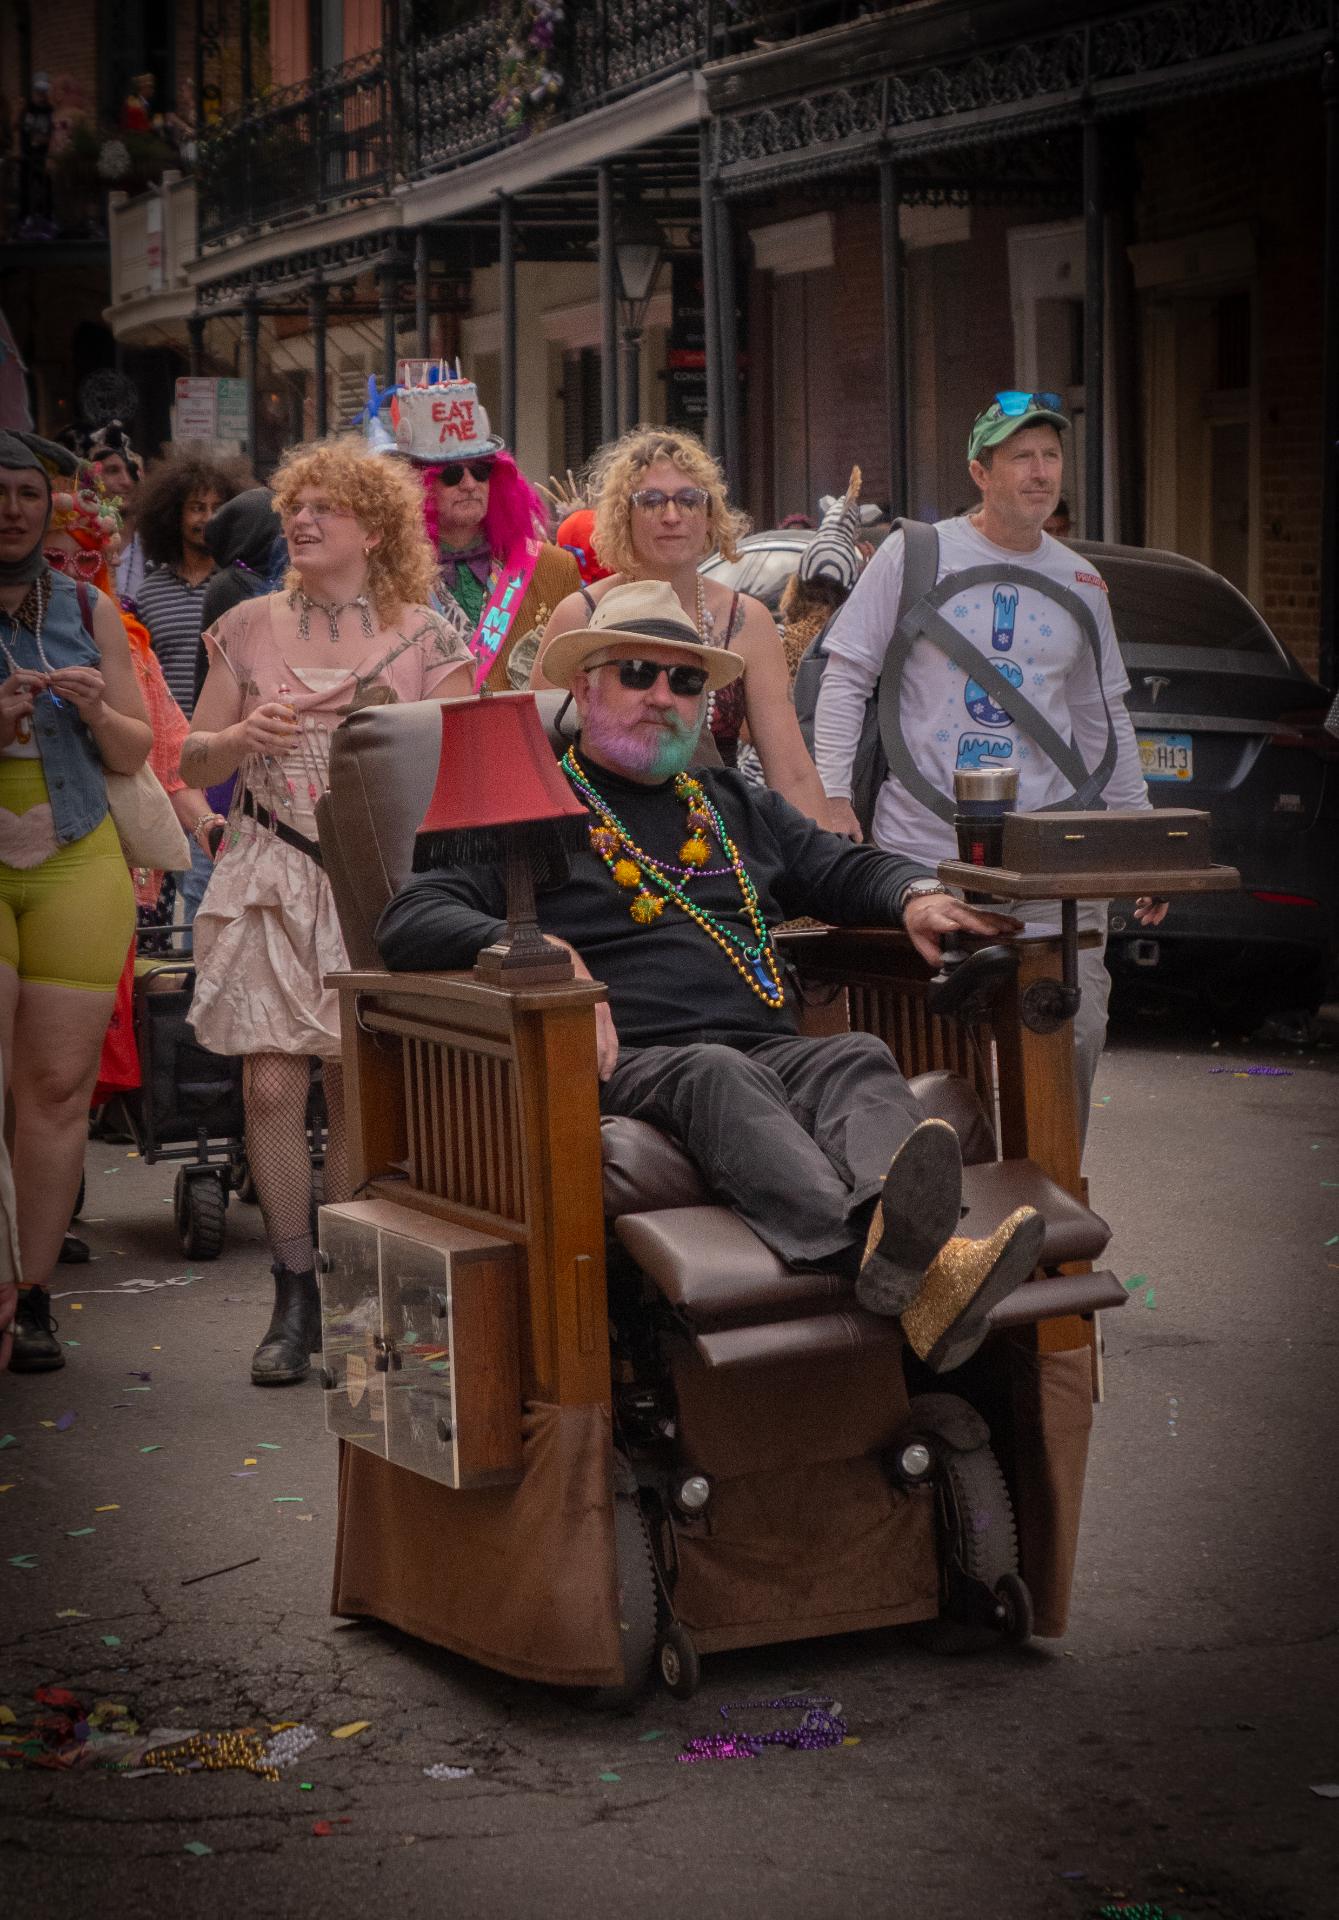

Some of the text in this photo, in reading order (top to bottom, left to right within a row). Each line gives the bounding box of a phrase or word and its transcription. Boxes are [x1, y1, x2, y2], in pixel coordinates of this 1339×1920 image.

[432, 400, 474, 422] EAT
[439, 419, 477, 443] ME
[1158, 747, 1188, 768] H13
